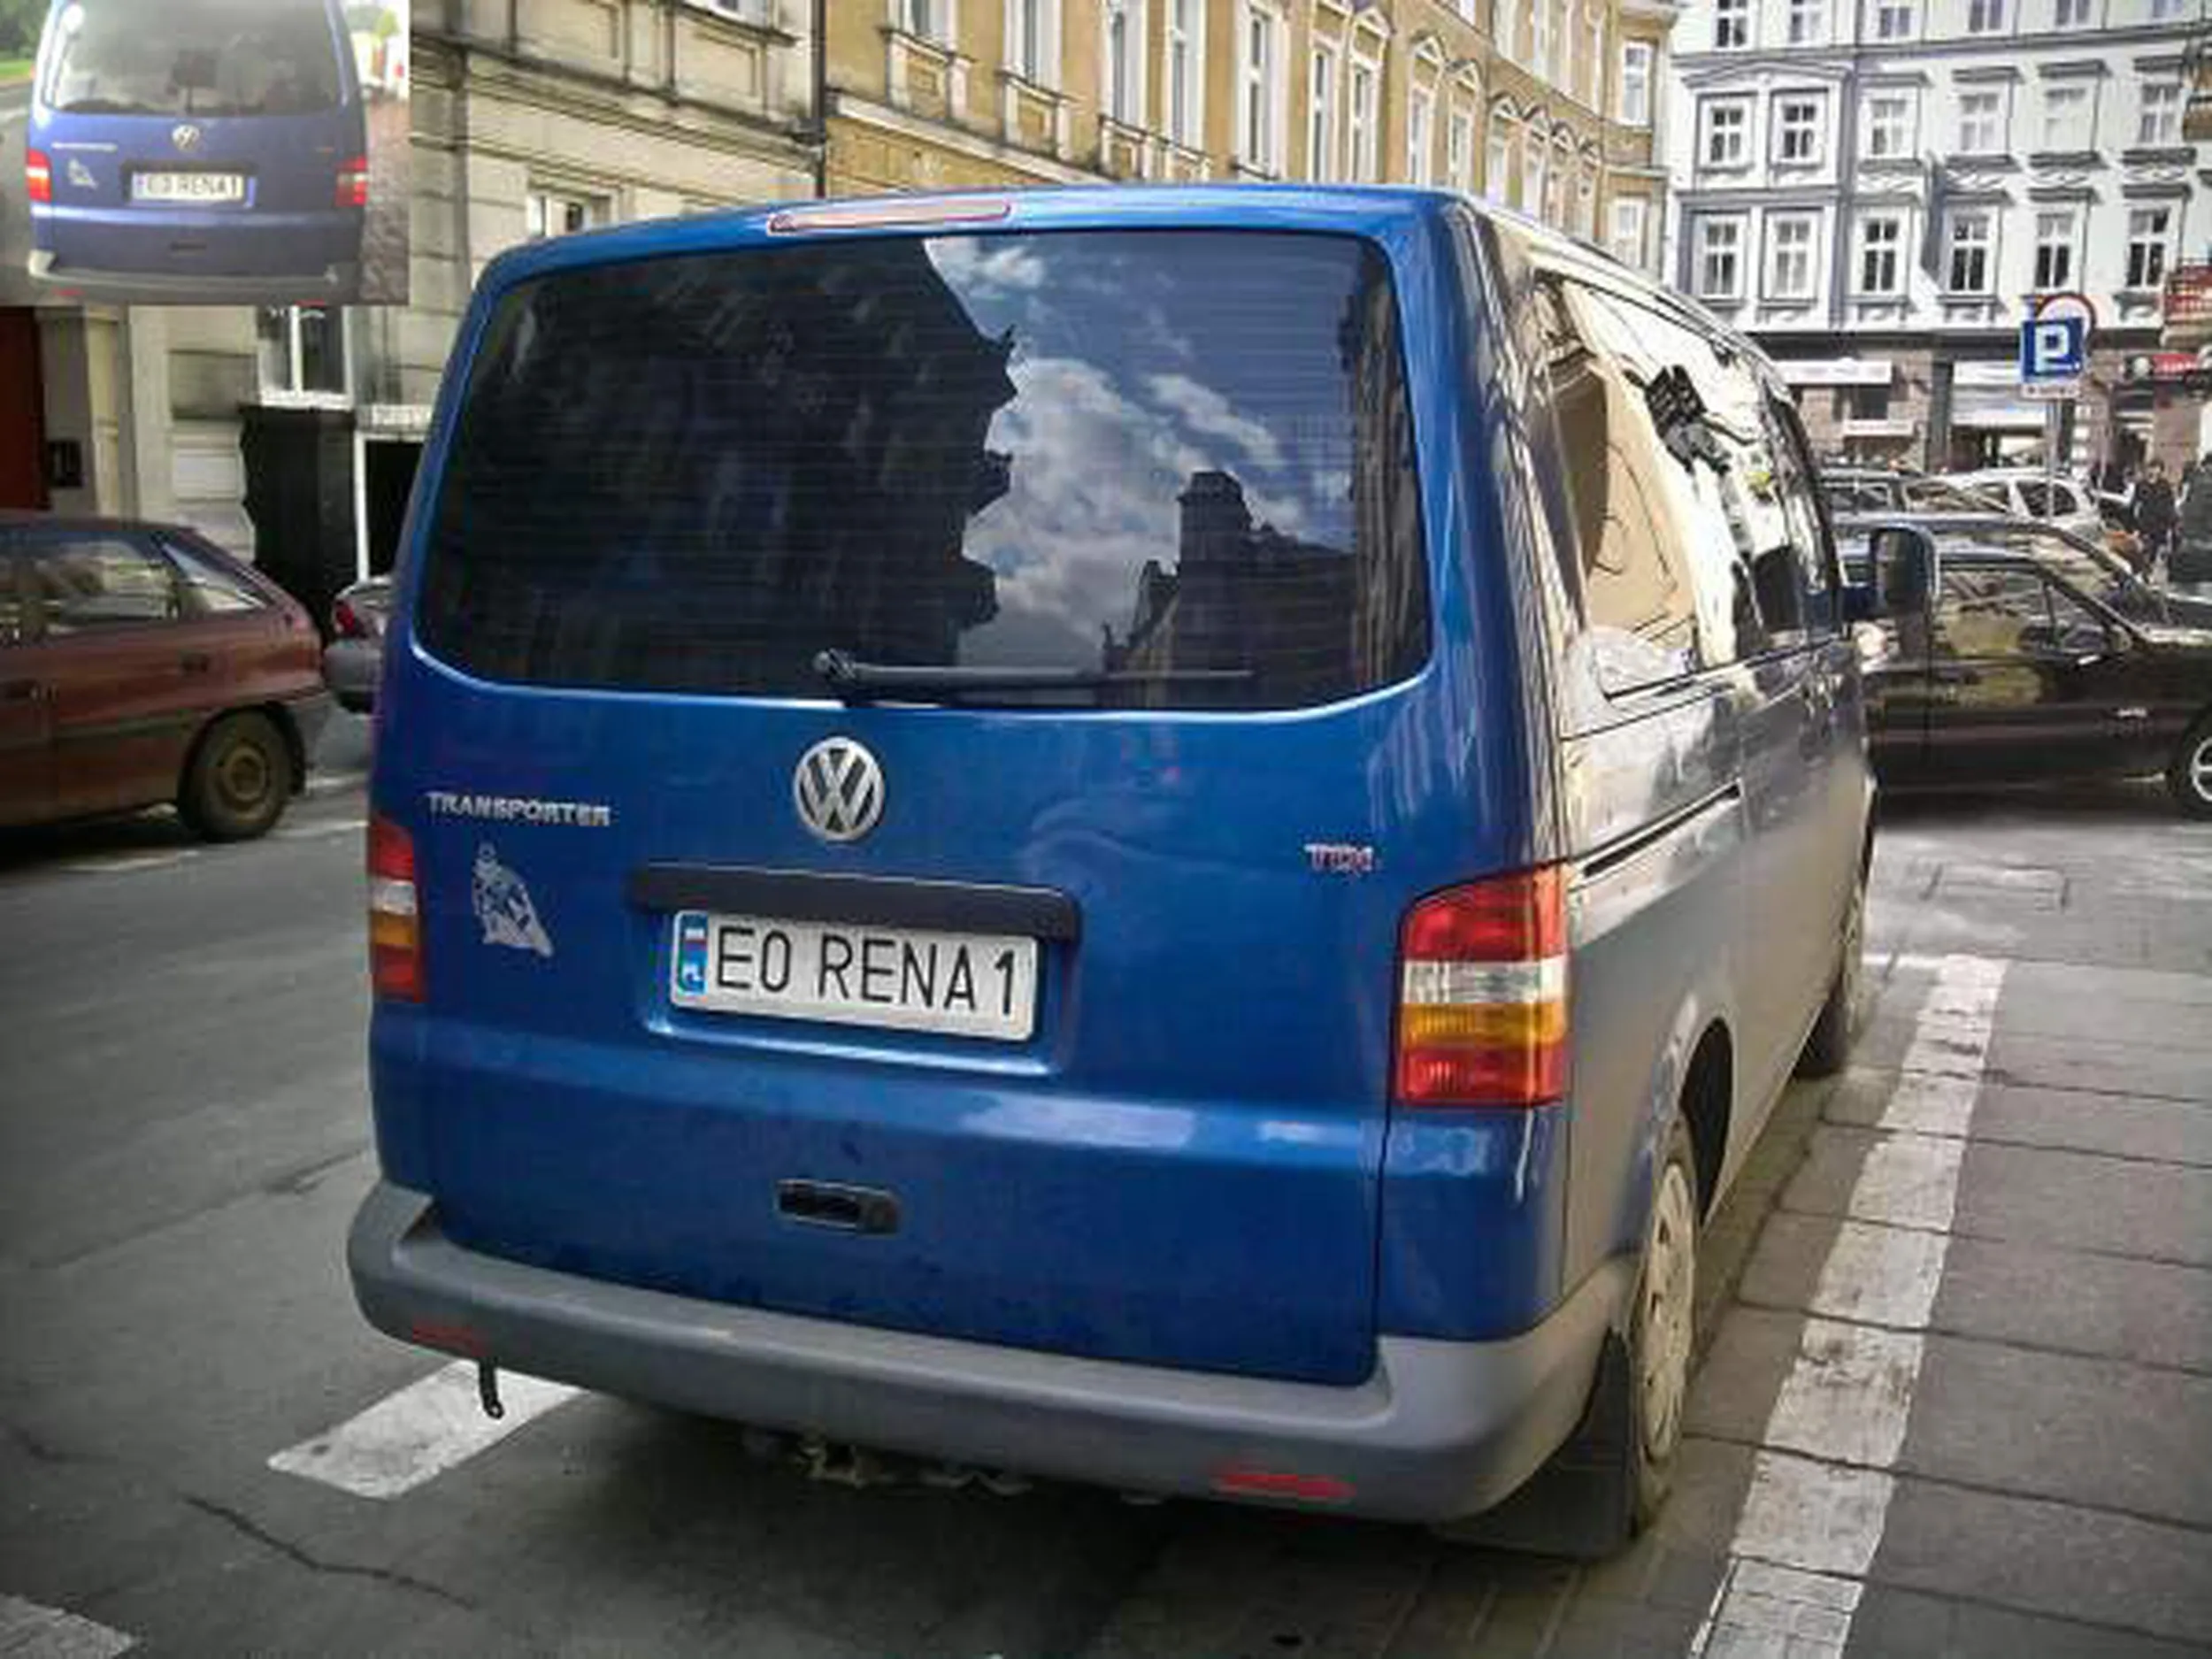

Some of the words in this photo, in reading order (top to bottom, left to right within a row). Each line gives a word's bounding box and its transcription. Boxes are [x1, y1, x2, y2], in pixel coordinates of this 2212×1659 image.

[2034, 324, 2069, 373] P
[425, 791, 611, 826] TRANSPORTER
[818, 933, 1015, 1017] RENA1
